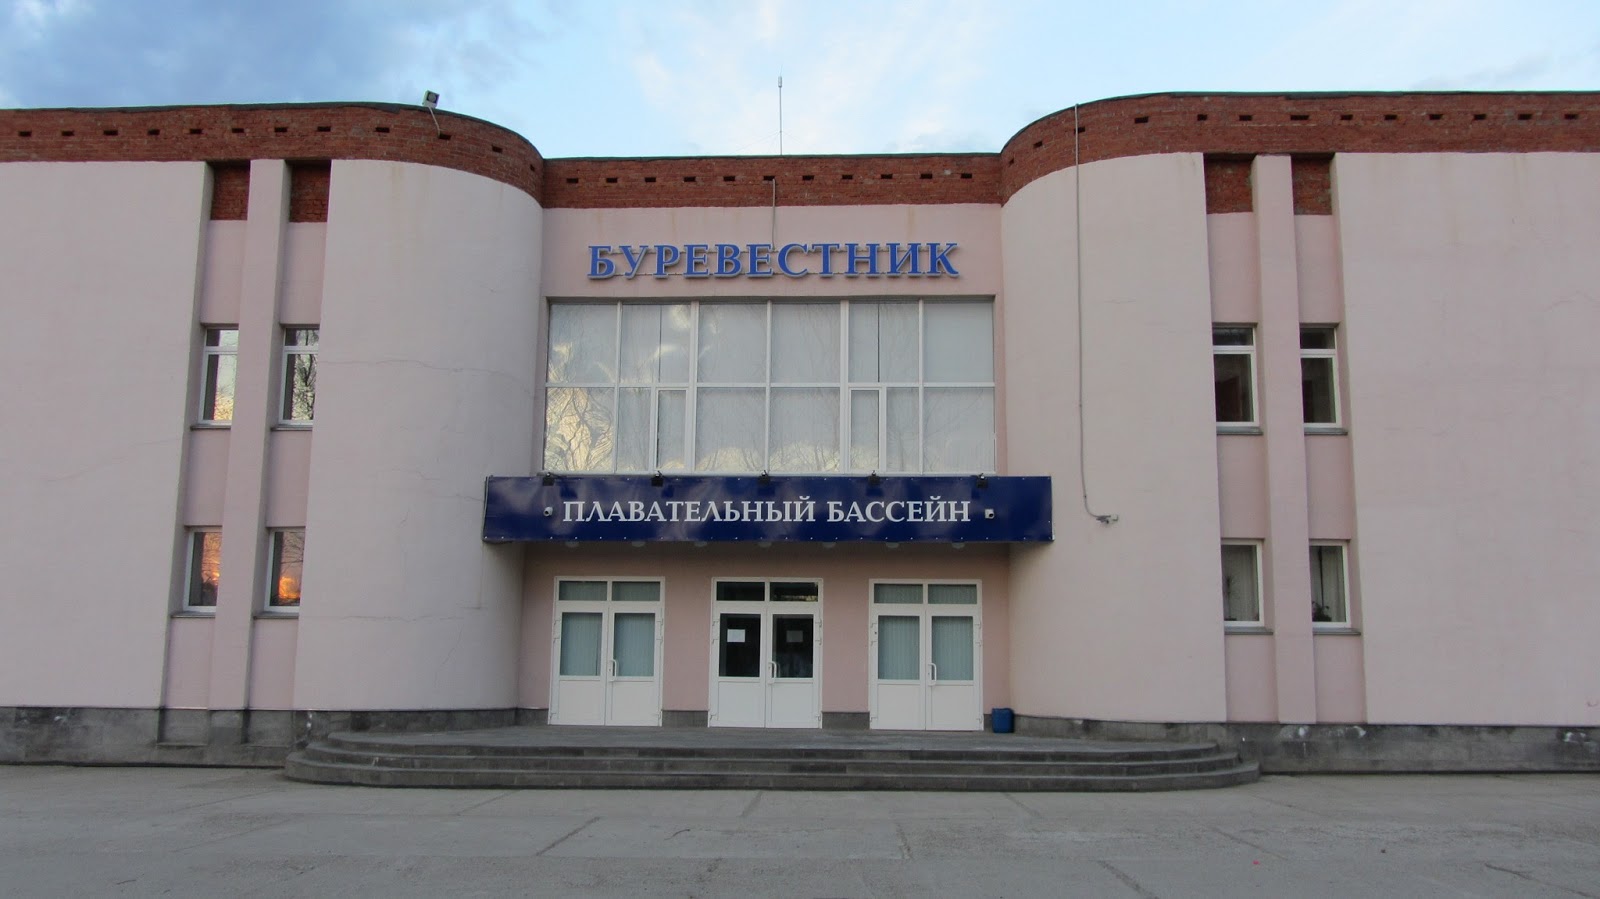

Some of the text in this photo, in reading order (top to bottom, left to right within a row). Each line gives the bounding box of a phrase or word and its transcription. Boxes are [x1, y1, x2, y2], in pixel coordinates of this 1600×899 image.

[587, 242, 960, 279] БУРЕВЕСТНИК
[562, 495, 971, 523] ПЛАВАТЕЛЬНЫЙ БАССЕЙН
